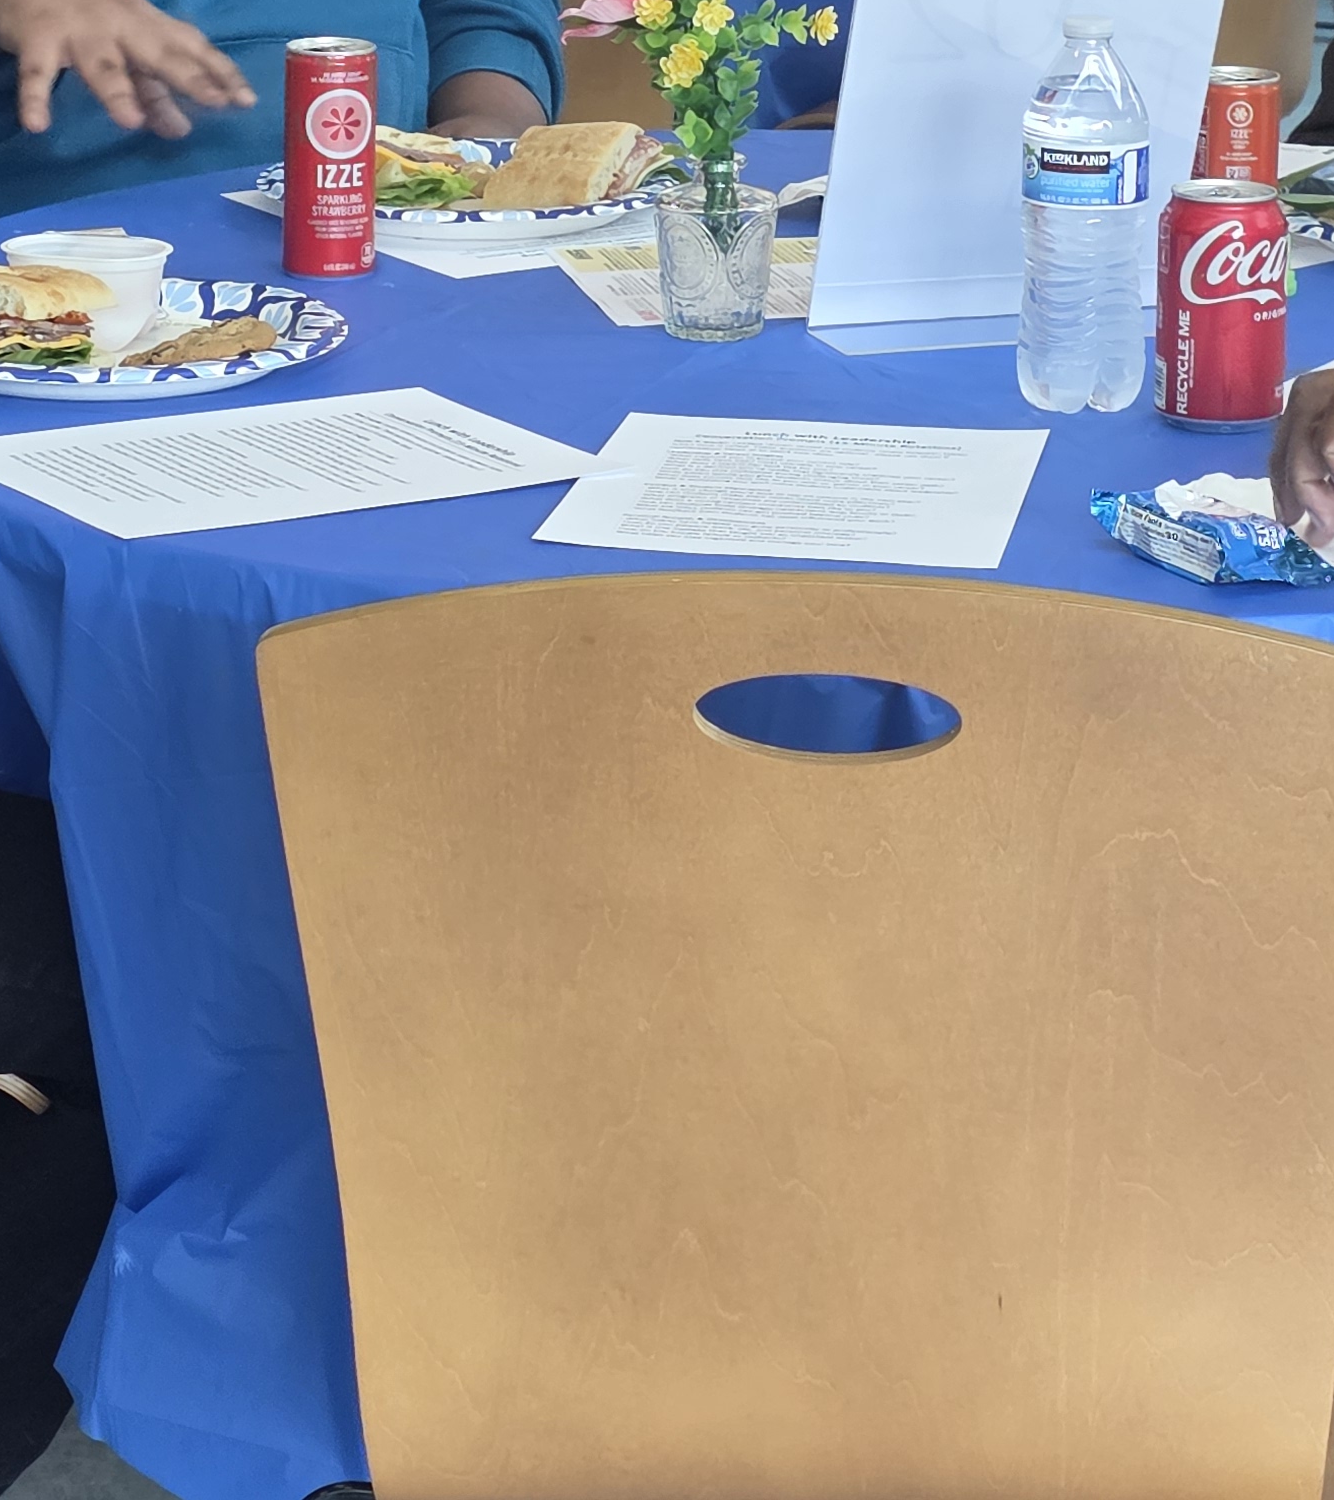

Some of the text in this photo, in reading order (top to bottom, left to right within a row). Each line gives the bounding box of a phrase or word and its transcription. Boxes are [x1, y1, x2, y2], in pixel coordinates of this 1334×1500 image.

[316, 162, 367, 189] IZZE
[1040, 176, 1111, 188] purified water
[316, 192, 364, 205] SPARKLING
[311, 204, 367, 217] STRAWBERRY
[1176, 308, 1191, 415] RECYCLE ME
